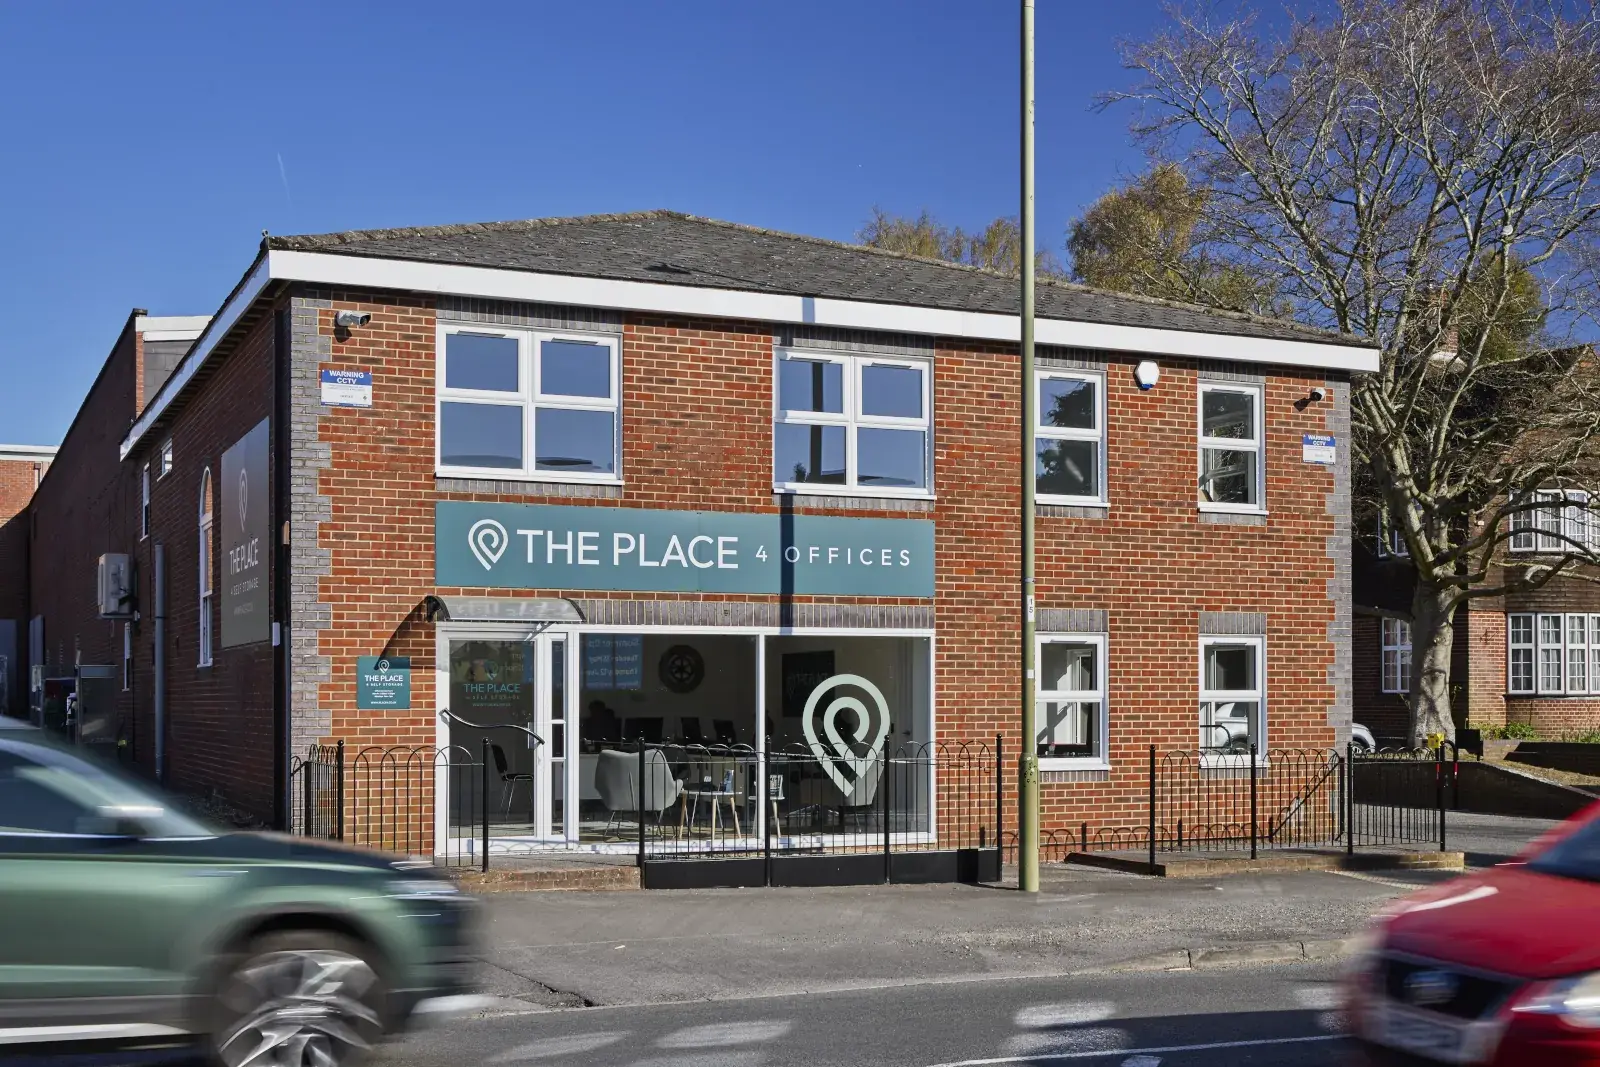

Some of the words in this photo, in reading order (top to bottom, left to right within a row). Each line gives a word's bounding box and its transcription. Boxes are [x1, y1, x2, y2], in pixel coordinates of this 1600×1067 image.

[329, 370, 364, 378] WARNING
[230, 548, 240, 575] THE
[240, 538, 258, 571] PLACE
[517, 529, 599, 566] THE
[613, 531, 738, 569] PLACE
[755, 545, 768, 563] 4
[784, 546, 910, 566] OFFICES
[463, 683, 484, 693] THE
[487, 683, 521, 693] PLACE
